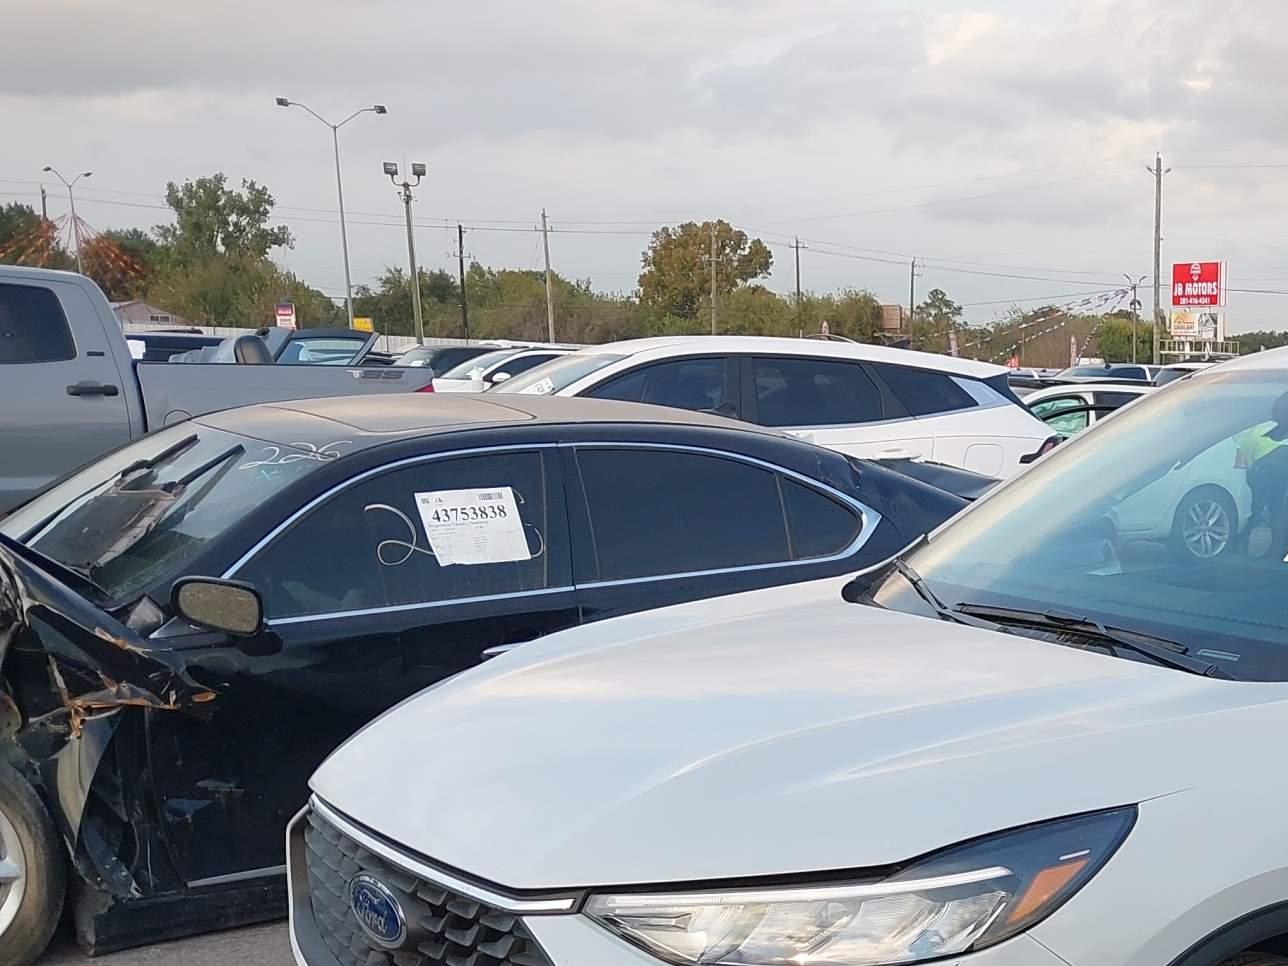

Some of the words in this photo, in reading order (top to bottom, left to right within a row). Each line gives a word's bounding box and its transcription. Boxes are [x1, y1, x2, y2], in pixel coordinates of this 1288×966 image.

[1174, 283, 1183, 296] JB
[1185, 281, 1217, 295] MOTORS
[432, 505, 507, 523] 43753838
